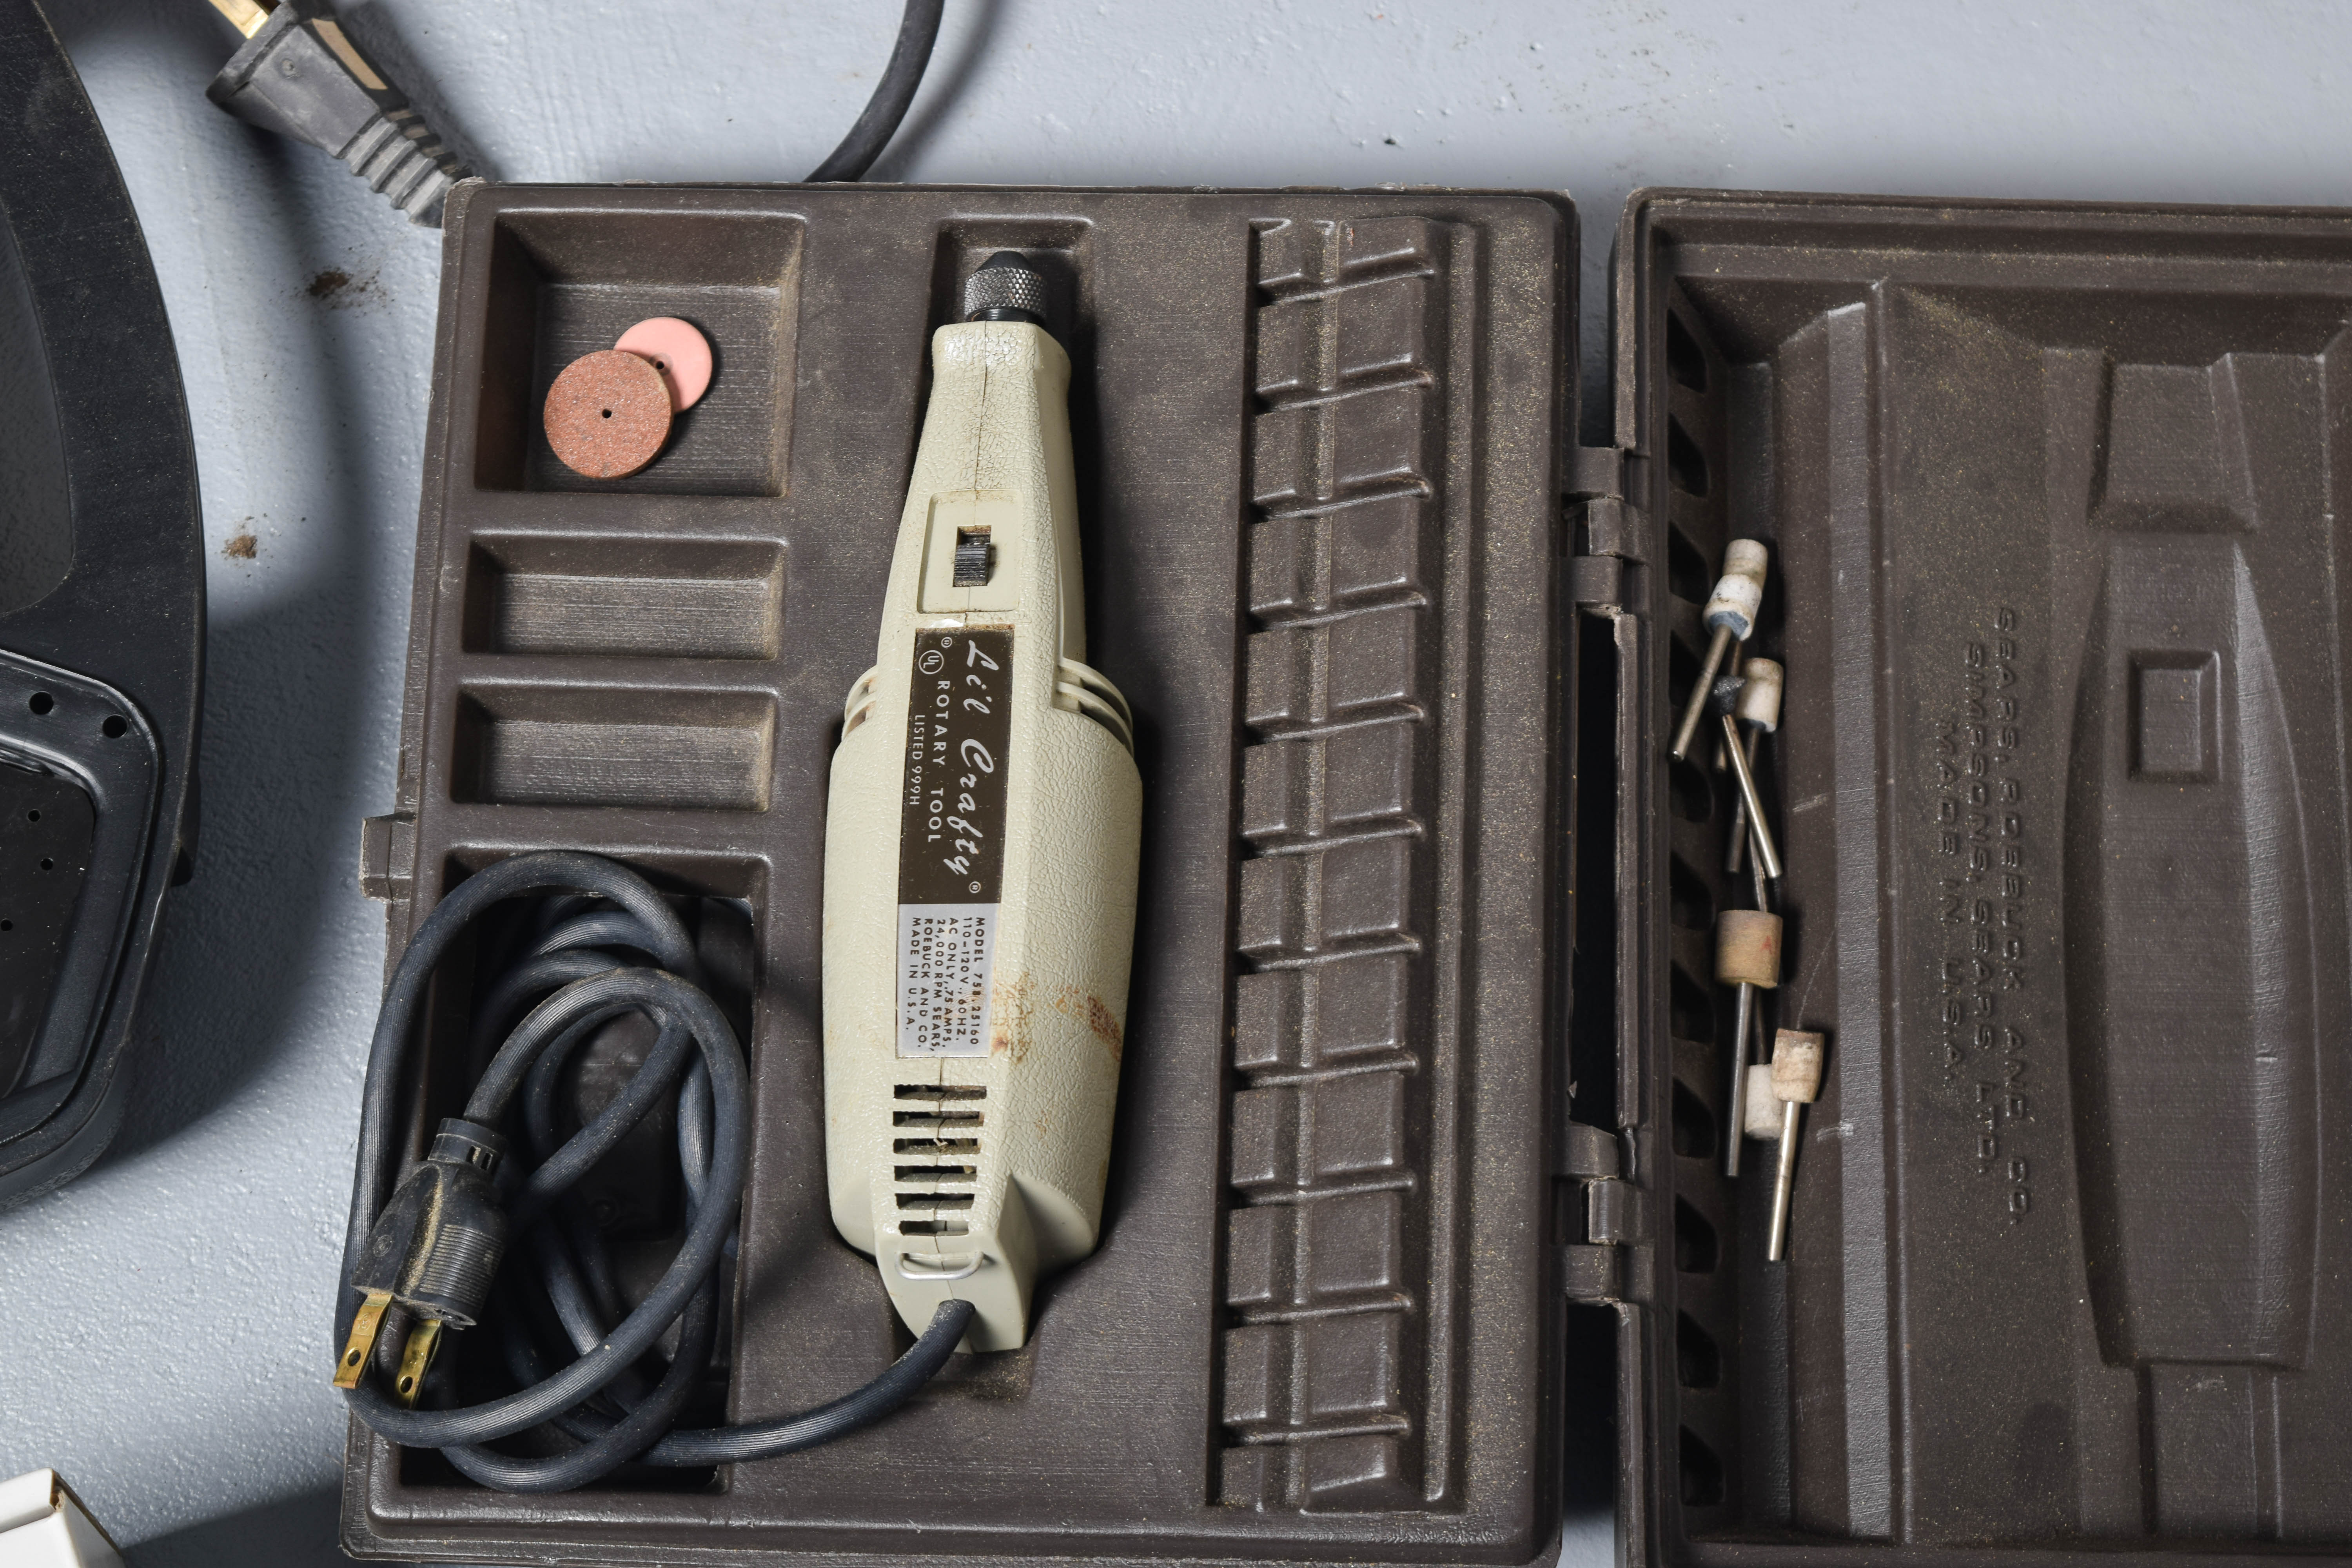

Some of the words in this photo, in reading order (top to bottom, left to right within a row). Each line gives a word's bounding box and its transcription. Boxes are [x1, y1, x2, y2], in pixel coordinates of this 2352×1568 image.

[963, 640, 999, 714] Li'l
[912, 715, 925, 760] LISTED
[933, 681, 950, 765] ROTARY
[909, 766, 922, 805] 999H
[943, 739, 994, 875] Crafty
[1935, 720, 1961, 856] MADE
[928, 788, 944, 842] TOOL
[1939, 878, 1962, 924] IN
[1999, 778, 2024, 991] ROEBUCK
[910, 917, 921, 955] MADE
[921, 918, 933, 978] ROEBUCK
[935, 919, 946, 966] 24,000
[949, 918, 958, 934] AC
[974, 917, 985, 962] MODEL
[909, 965, 918, 978] IN
[934, 973, 942, 998] RPM
[1971, 899, 1995, 1049] SEARS
[906, 988, 917, 1030] U.S.A.
[920, 987, 929, 1016] AND
[970, 973, 982, 1045] 758.25160
[1941, 958, 1966, 1081] U.S.A.
[918, 1025, 927, 1047] CO.
[929, 1007, 942, 1052] SEARS,
[942, 1008, 953, 1047] AMPS.
[2004, 1027, 2027, 1120] AND
[1975, 1082, 2000, 1174] LTD.
[2007, 1158, 2031, 1225] CO.
